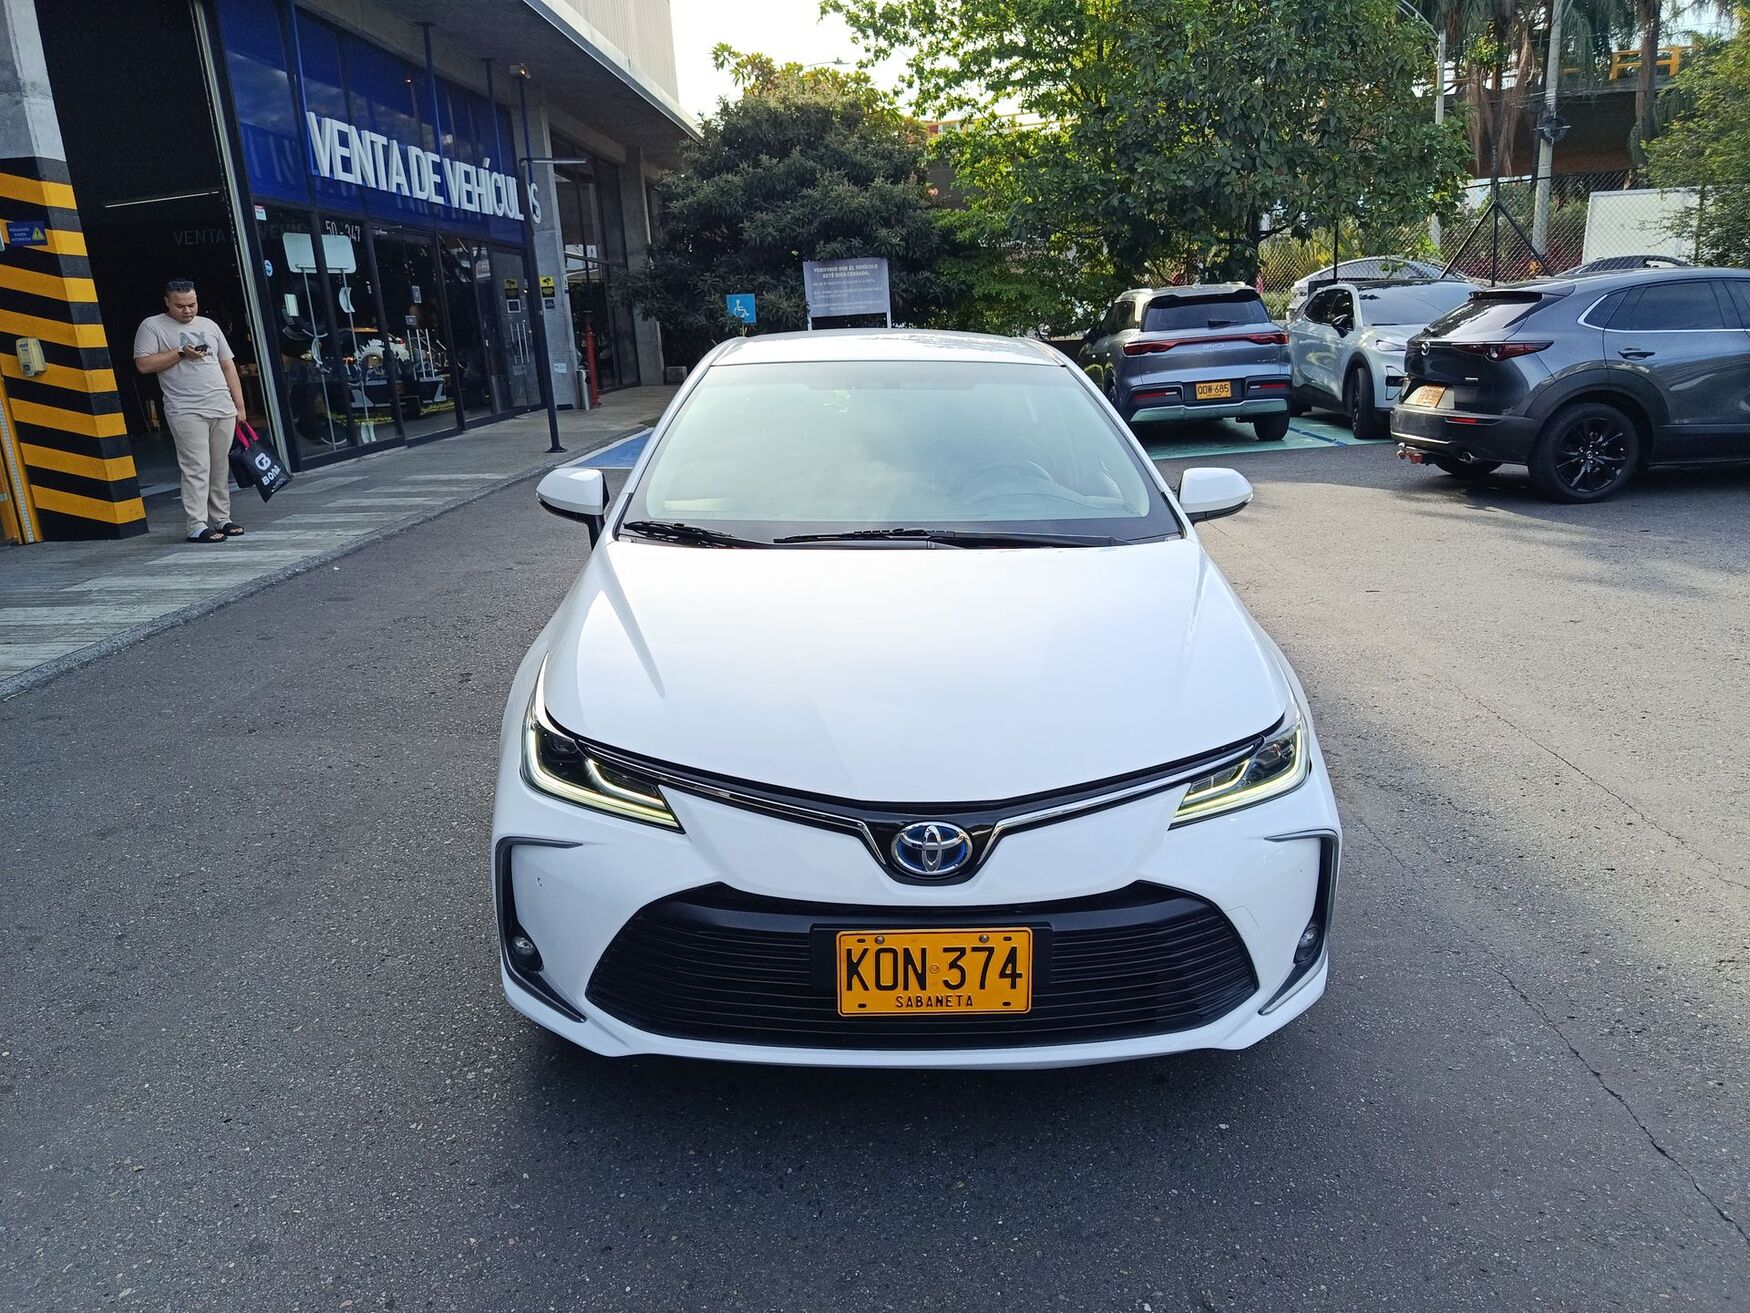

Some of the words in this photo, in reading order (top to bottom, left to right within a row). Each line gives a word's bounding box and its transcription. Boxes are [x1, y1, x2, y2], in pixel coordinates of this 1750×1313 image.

[306, 112, 411, 197] VENTA
[408, 146, 445, 205] DE
[443, 157, 541, 224] VEHÍCULS
[846, 947, 927, 991] KON
[942, 946, 1023, 990] 374
[895, 994, 973, 1008] SABANETA
